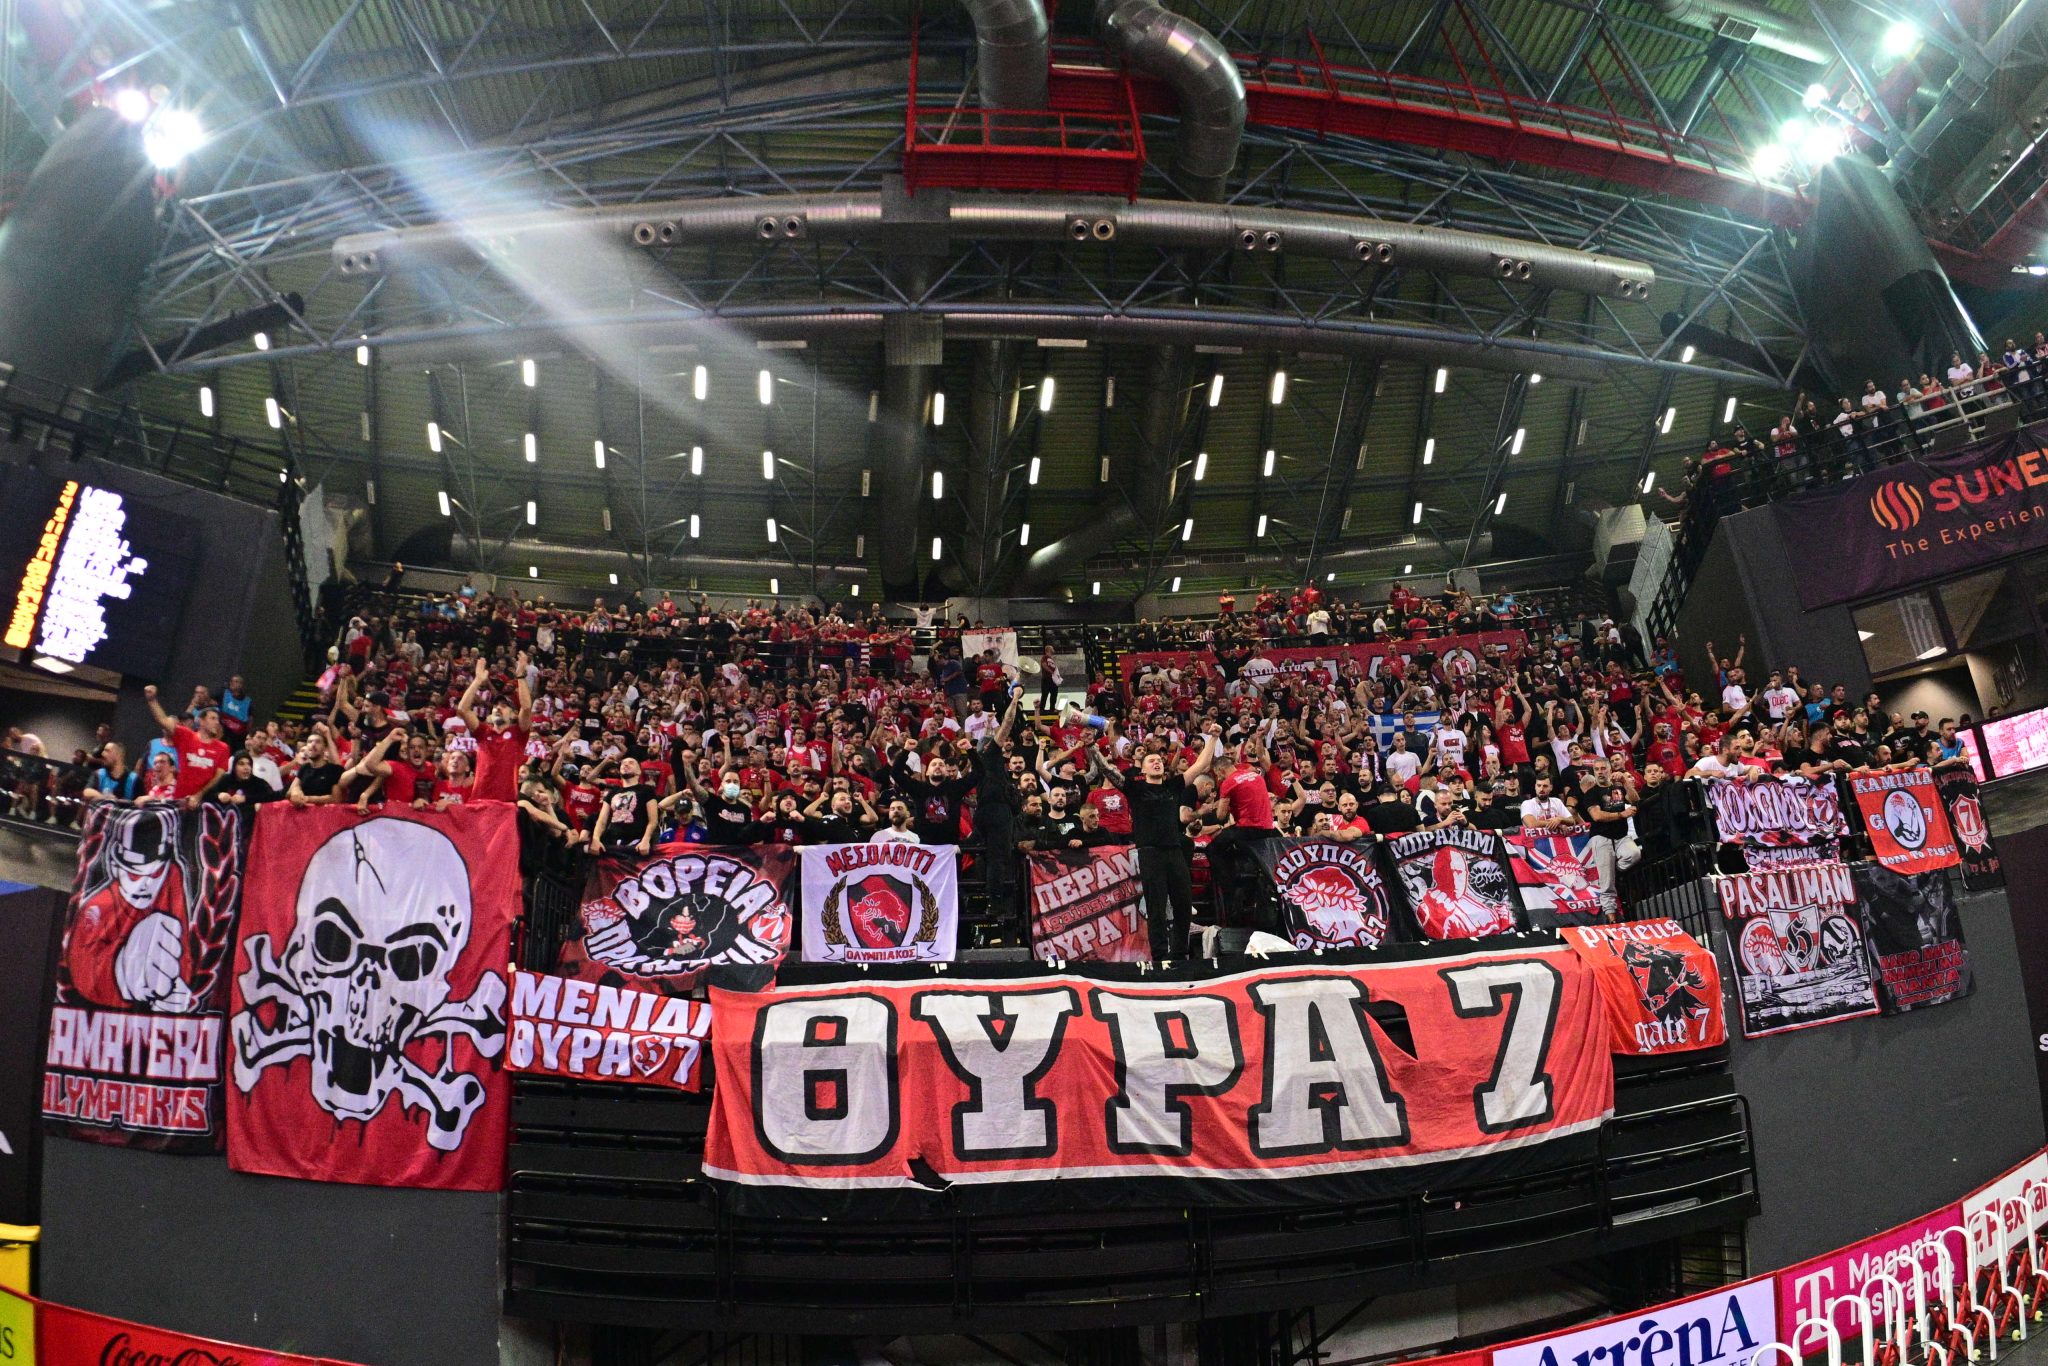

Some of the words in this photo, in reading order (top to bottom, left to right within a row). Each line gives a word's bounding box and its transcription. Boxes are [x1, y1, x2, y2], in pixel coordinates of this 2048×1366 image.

[1928, 446, 2048, 512] SUNE
[1886, 537, 1930, 559] The
[1940, 505, 2046, 545] Experien
[1853, 771, 1934, 794] KAMINIA
[1869, 813, 1886, 831] G
[825, 843, 937, 877] ΜΕΣΟΛΟΓΓΙ
[613, 855, 776, 925] ΒΟΡΕΙΑ
[1568, 899, 1601, 911] GATE
[1121, 903, 1139, 934] 7
[846, 949, 916, 961] ΟΛΥΜΠΙΑΚΟΣ
[509, 1019, 632, 1077] ΘΥΡΑ
[672, 1036, 701, 1085] 7
[1634, 1013, 1688, 1053] gate
[1693, 1007, 1711, 1042] 7
[752, 977, 1411, 1166] ΘΥΡΑ
[1440, 959, 1562, 1133] 7
[1848, 1228, 1946, 1289] Magenta
